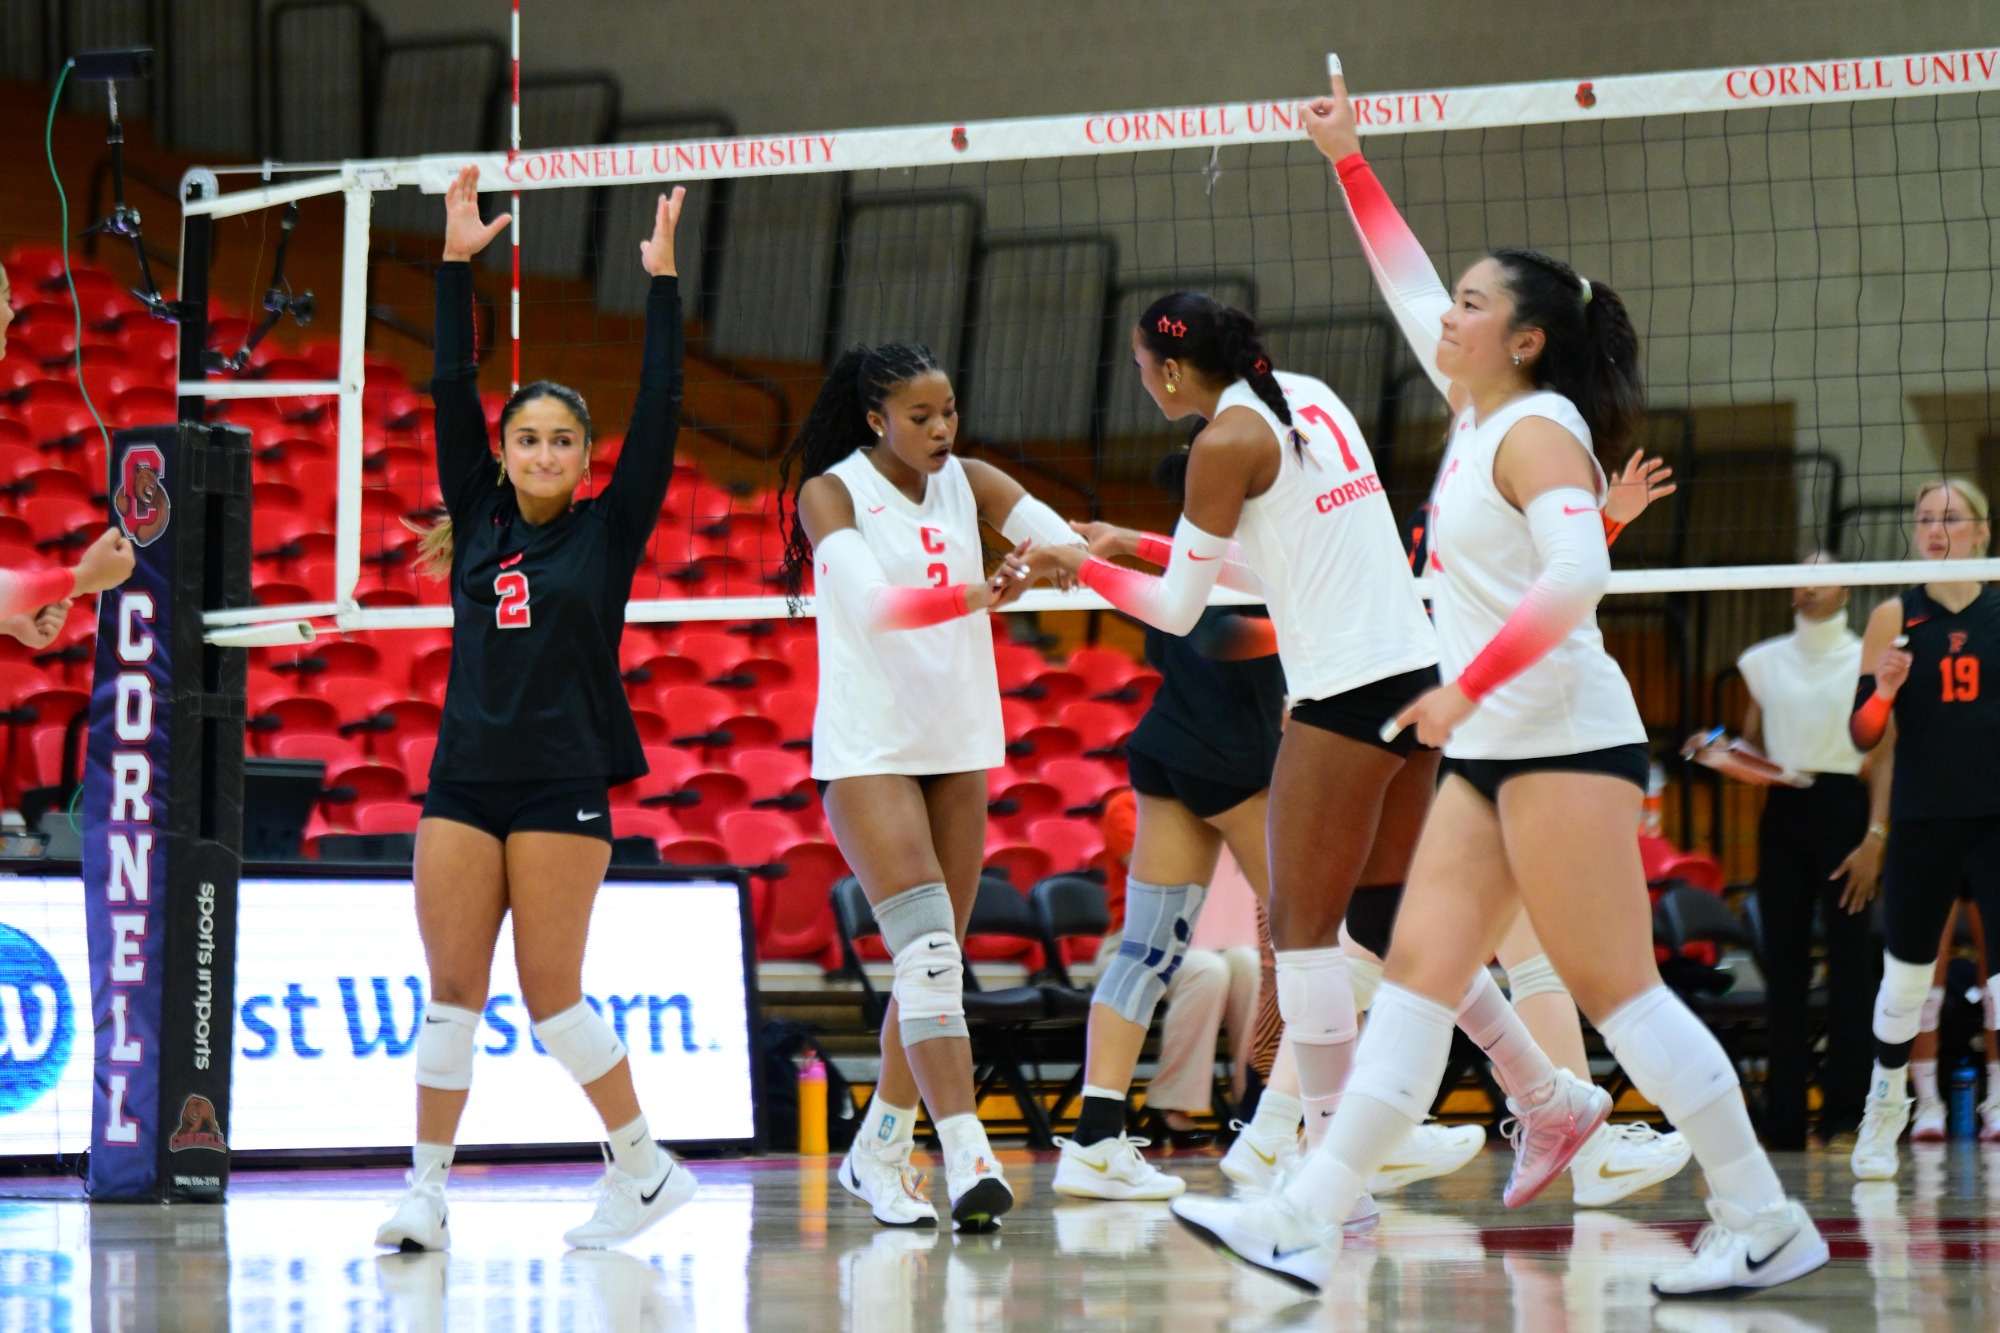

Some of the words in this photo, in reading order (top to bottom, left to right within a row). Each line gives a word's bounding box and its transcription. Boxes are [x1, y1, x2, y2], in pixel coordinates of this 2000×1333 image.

[1726, 60, 1893, 99] CORNELL
[1904, 51, 1998, 86] UNIV
[1085, 107, 1235, 145] CORNELL
[1246, 94, 1450, 134] UNIRSITY
[505, 149, 643, 183] CORNELL
[652, 136, 837, 174] UNIVERSITY
[1297, 404, 1360, 473] 7
[920, 526, 946, 555] C
[494, 570, 531, 629] 2
[1939, 655, 1980, 703] 19
[104, 591, 156, 1147] CORNELL
[196, 881, 216, 966] sports
[192, 968, 213, 1071] imports
[240, 982, 324, 1060] st
